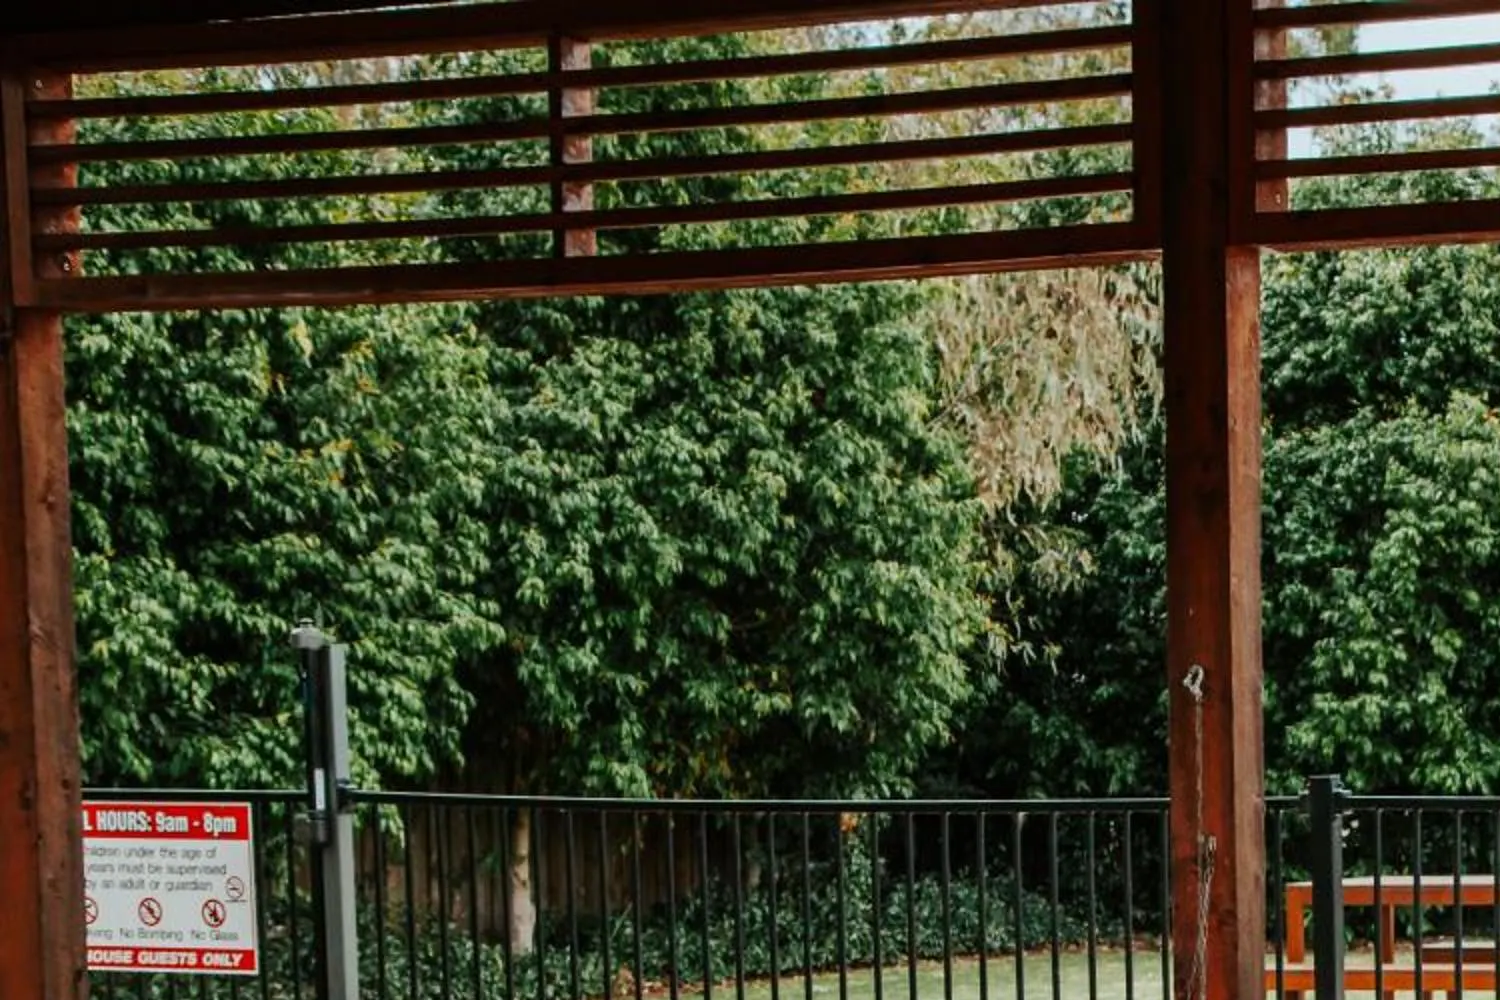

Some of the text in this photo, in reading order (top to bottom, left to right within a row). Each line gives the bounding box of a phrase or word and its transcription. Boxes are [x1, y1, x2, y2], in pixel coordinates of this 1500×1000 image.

[96, 810, 151, 832] HOURS:
[156, 812, 189, 833] 9am
[203, 812, 237, 836] 8pm
[137, 951, 197, 966] GUESTS
[202, 953, 244, 967] ONLY
